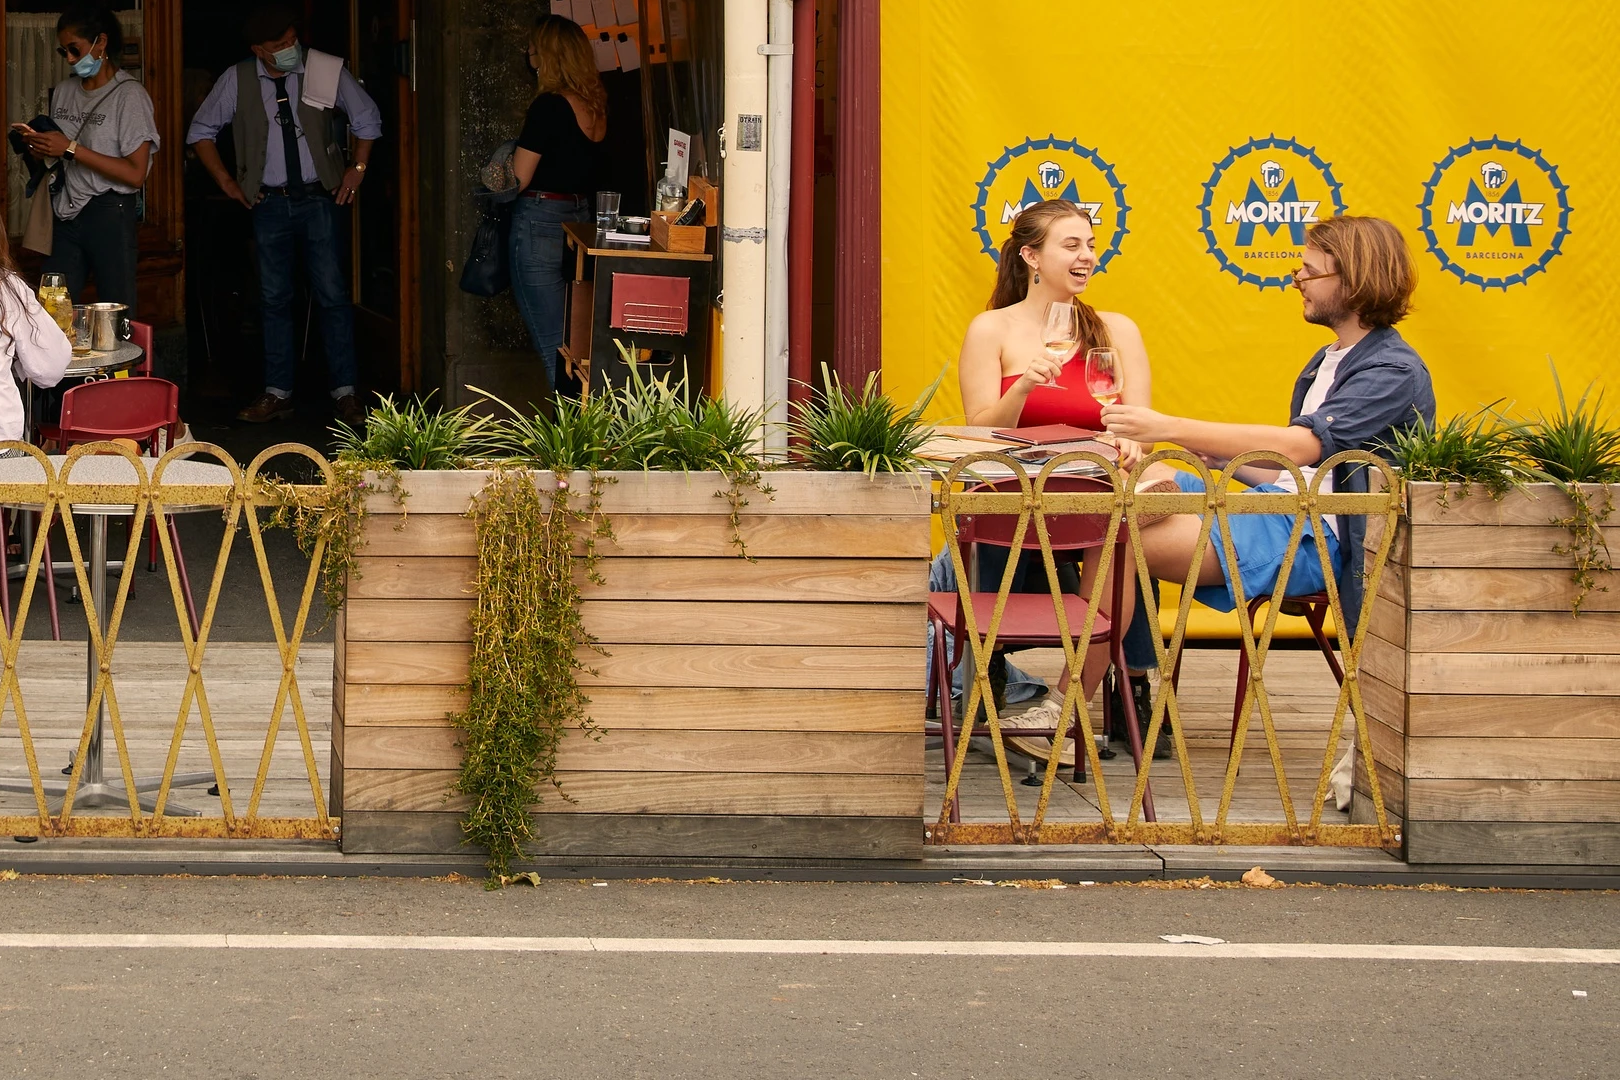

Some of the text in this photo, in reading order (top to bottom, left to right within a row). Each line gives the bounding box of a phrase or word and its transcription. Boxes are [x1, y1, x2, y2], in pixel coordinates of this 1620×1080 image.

[1225, 199, 1321, 225] MORITZ
[1446, 199, 1546, 226] MORITZ
[1244, 251, 1303, 259] BARCELONA
[1466, 251, 1524, 260] BARCELONA
